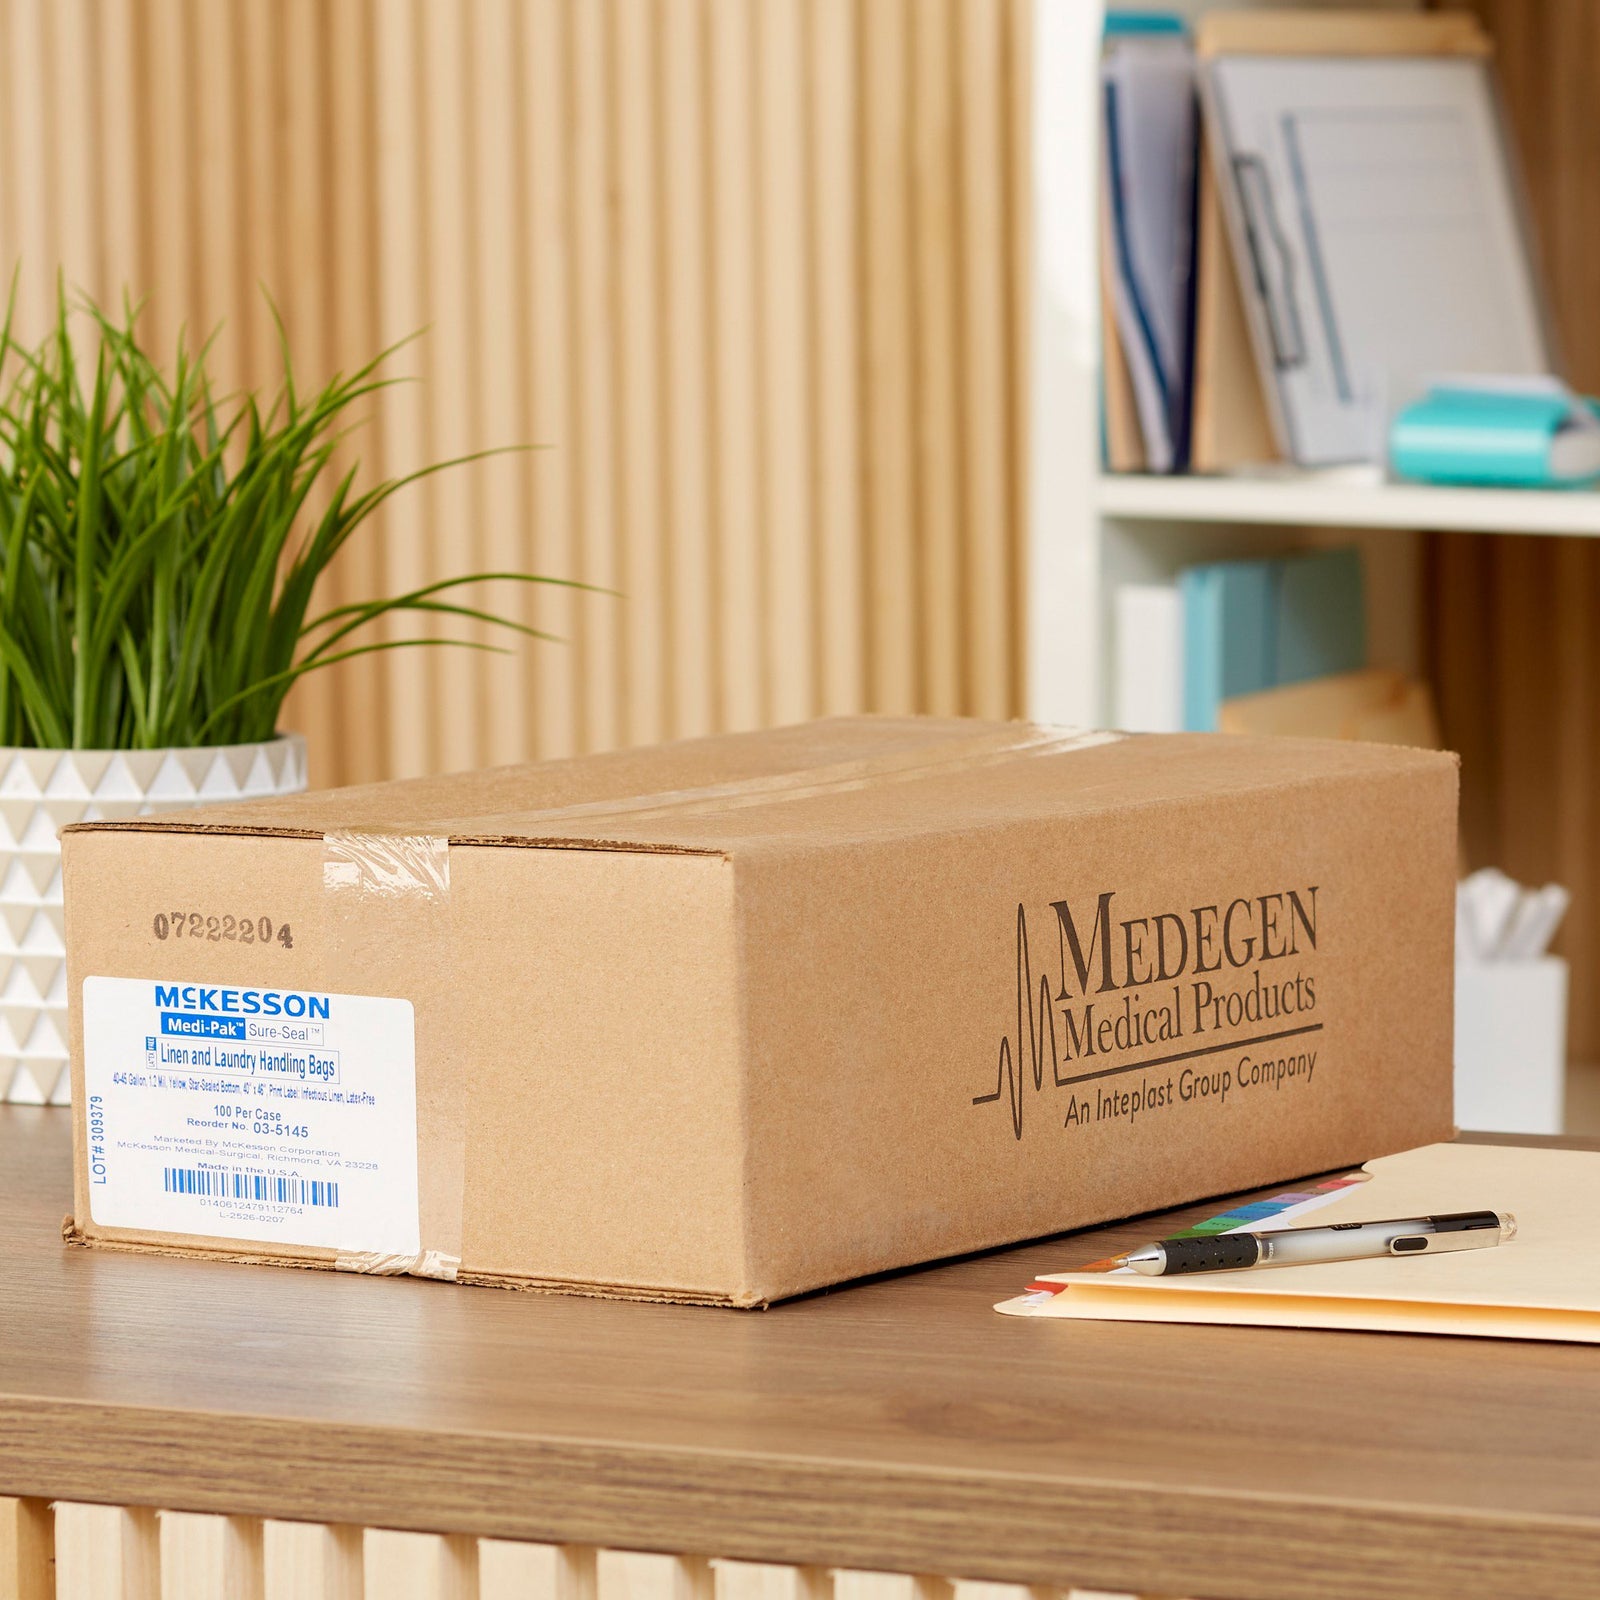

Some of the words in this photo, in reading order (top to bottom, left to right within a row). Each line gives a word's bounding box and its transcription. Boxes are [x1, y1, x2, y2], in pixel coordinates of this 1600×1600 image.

[153, 912, 294, 949] 07222204
[1049, 886, 1319, 1001] MEDEGEN
[1061, 987, 1183, 1061] Medical
[1191, 970, 1316, 1034] Products
[161, 1043, 189, 1065] Linen
[191, 1047, 211, 1067] and
[214, 1048, 256, 1075] Laundry
[259, 1050, 305, 1079] Handling
[308, 1054, 335, 1081] Bags
[301, 1086, 327, 1101] Infectious
[1064, 1094, 1090, 1128] An
[1097, 1078, 1173, 1123] Inteplast
[1179, 1068, 1231, 1102] Group
[1237, 1051, 1317, 1090] Company
[90, 1096, 104, 1141] 309379
[187, 1117, 228, 1129] Reorder
[232, 1121, 249, 1131] No.
[253, 1122, 309, 1138] 03-5145
[214, 1105, 231, 1117] 100
[236, 1107, 252, 1119] Per
[255, 1108, 281, 1121] Case
[92, 1146, 106, 1184] LOT#
[117, 1141, 171, 1152] McKesson
[326, 1159, 342, 1167] VA
[344, 1161, 379, 1170] 23228
[154, 1135, 202, 1145] Marketed
[205, 1139, 219, 1148] By
[222, 1141, 276, 1152] McKesson
[279, 1145, 340, 1158] Corporation
[197, 1162, 228, 1170] Made
[267, 1168, 303, 1178] U.S.A.
